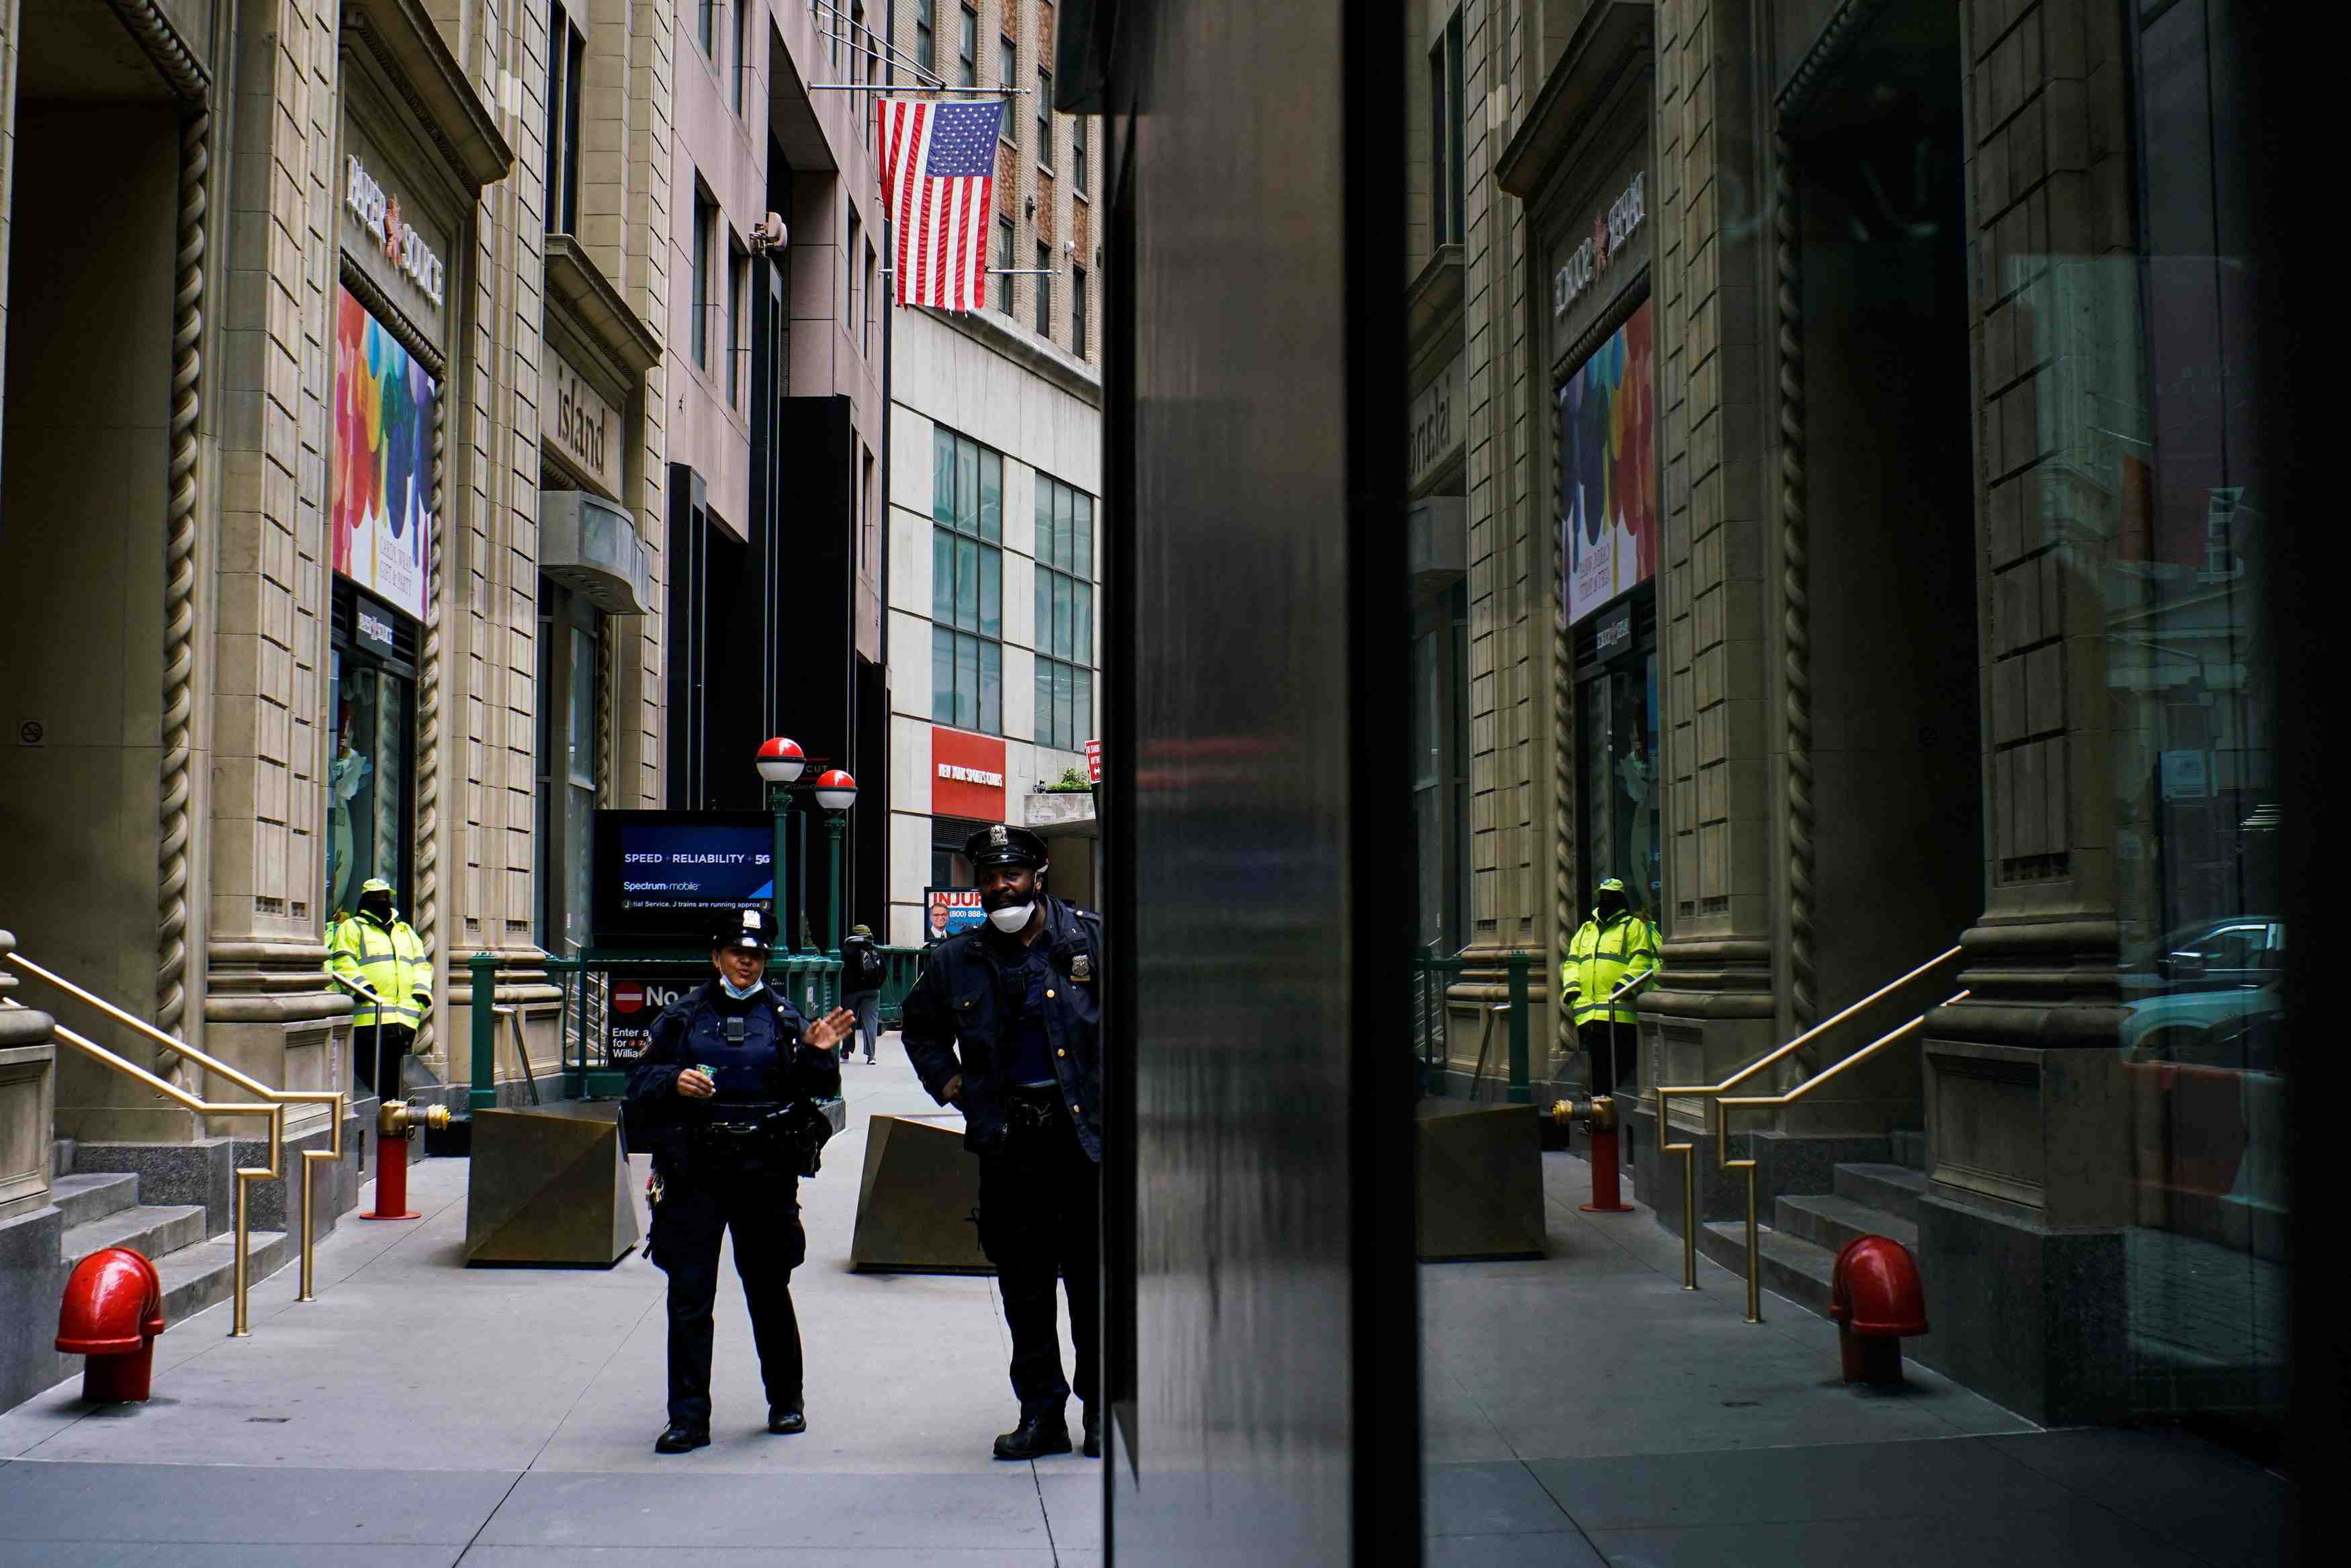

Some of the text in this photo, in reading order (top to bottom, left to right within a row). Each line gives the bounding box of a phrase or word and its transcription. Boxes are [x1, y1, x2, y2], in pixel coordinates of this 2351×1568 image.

[558, 365, 605, 475] island
[625, 854, 662, 863] SPEED
[672, 854, 745, 864] RELIABILITY
[755, 855, 770, 865] 5G
[623, 881, 699, 892] Spectrum mobile
[934, 892, 982, 907] INJUR
[710, 901, 736, 909] running
[949, 910, 967, 918] (800)
[646, 986, 679, 1006] No
[612, 1028, 650, 1037] Enter a
[613, 1038, 627, 1048] for
[613, 1049, 638, 1058] Willia
